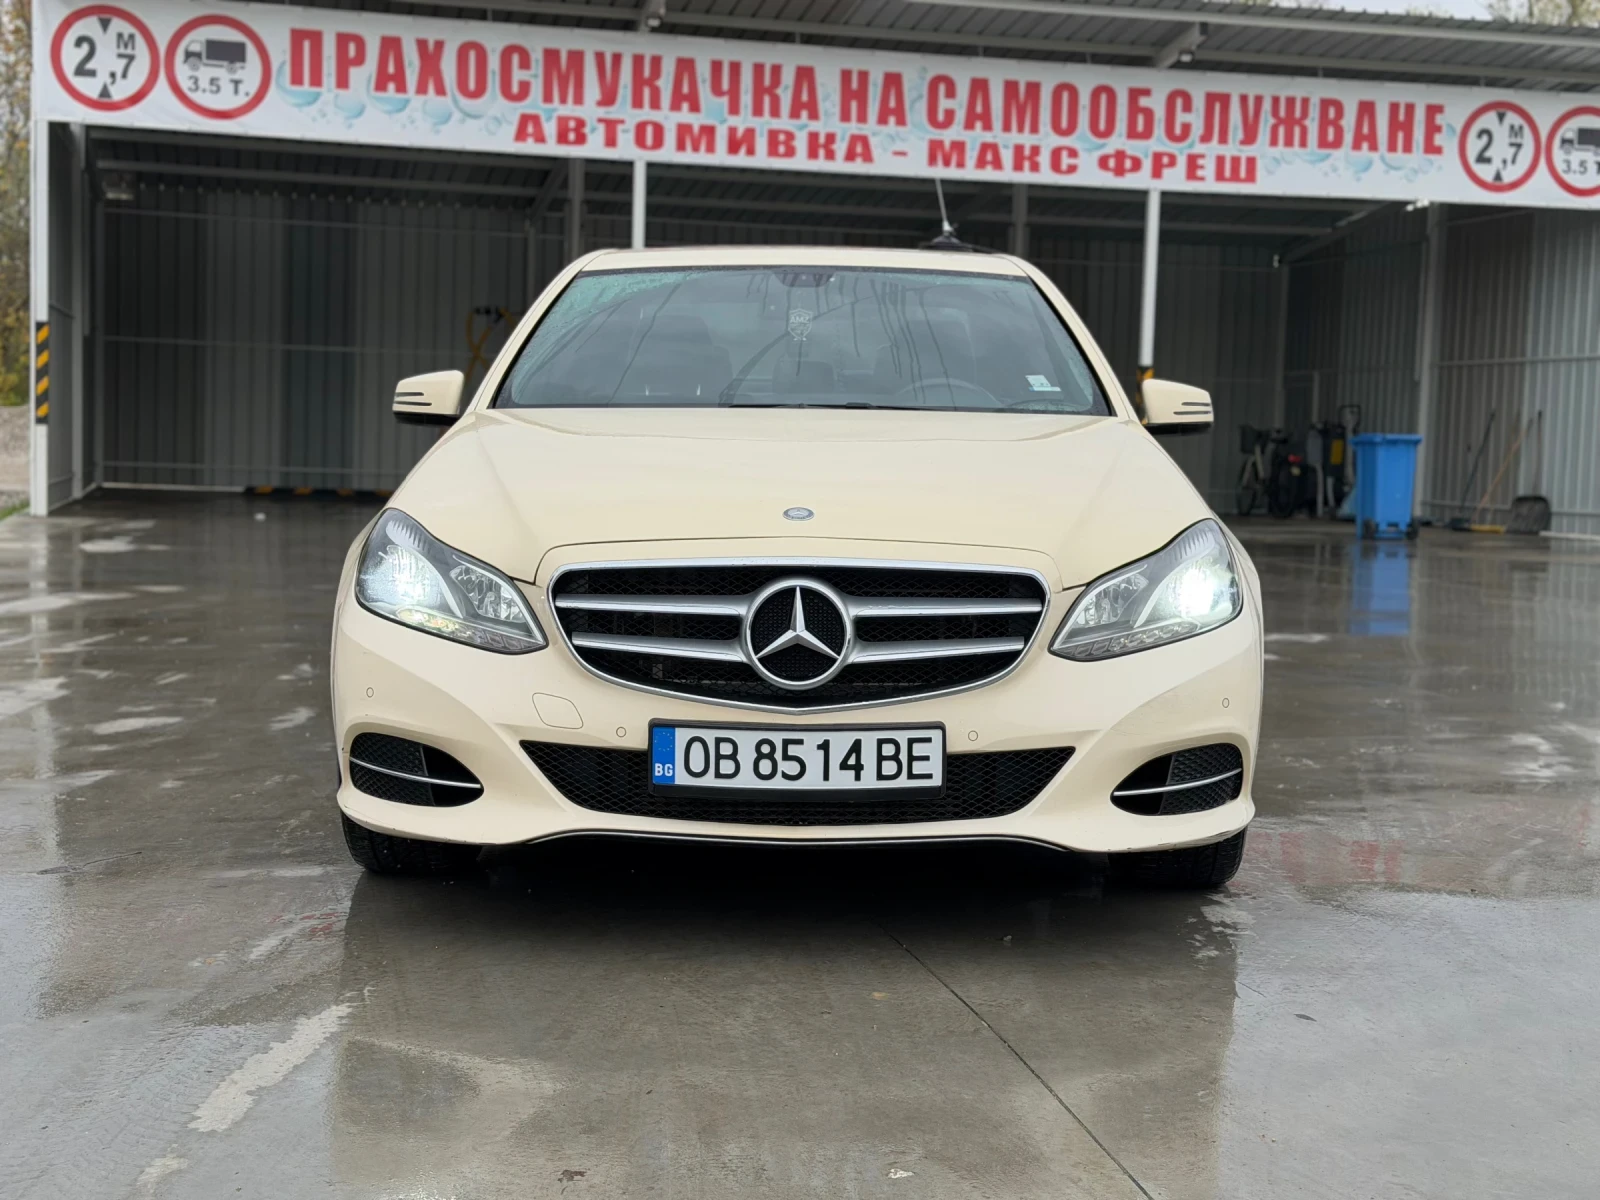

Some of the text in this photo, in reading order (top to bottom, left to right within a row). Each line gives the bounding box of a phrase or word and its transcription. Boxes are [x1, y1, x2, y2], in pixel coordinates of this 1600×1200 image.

[187, 75, 222, 95] 3.5
[290, 29, 1444, 156] ПРАХОСМУКАЧКА НА САМООБСЛУЖВАНЕ
[514, 113, 874, 163] АВТОМИВКА
[927, 138, 1079, 175] МАКС
[1097, 149, 1257, 184] ФРЕШ
[1561, 159, 1588, 175] 3.5
[654, 763, 674, 777] BG
[683, 735, 934, 782] OB 8514 BE
